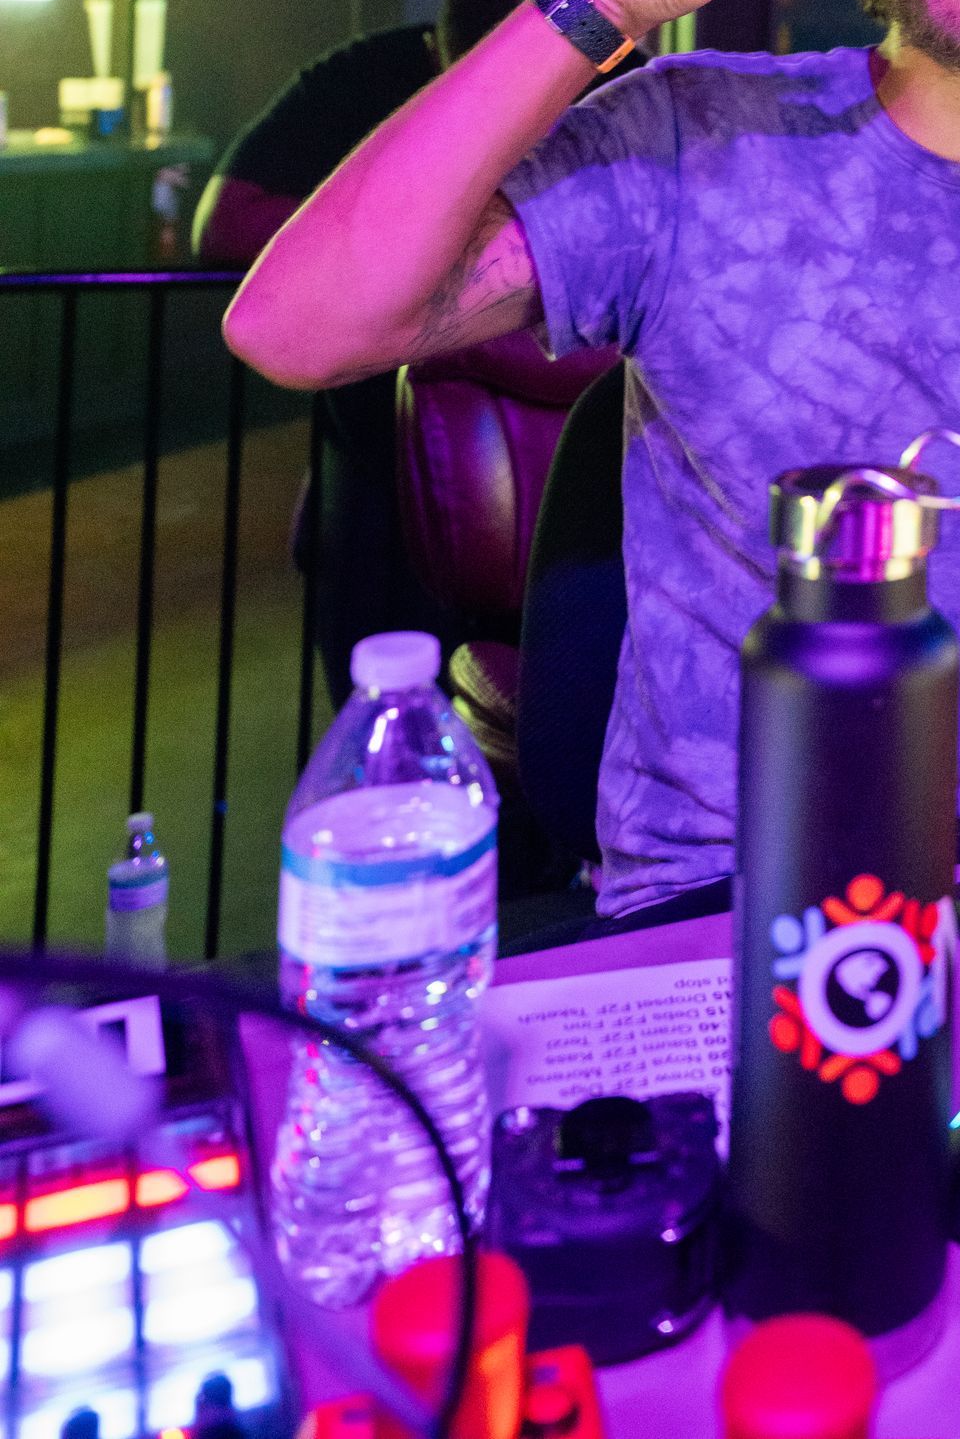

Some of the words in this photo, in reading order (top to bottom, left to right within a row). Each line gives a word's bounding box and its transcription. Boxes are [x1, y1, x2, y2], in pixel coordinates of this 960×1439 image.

[674, 976, 711, 990] stop
[637, 991, 707, 1010] Dropset
[597, 1002, 631, 1015] F2F
[612, 1015, 646, 1027] F2F
[600, 1031, 634, 1043] F2F
[602, 1046, 637, 1059] F2F
[610, 1062, 646, 1075] F2F
[612, 1077, 648, 1093] F2F
